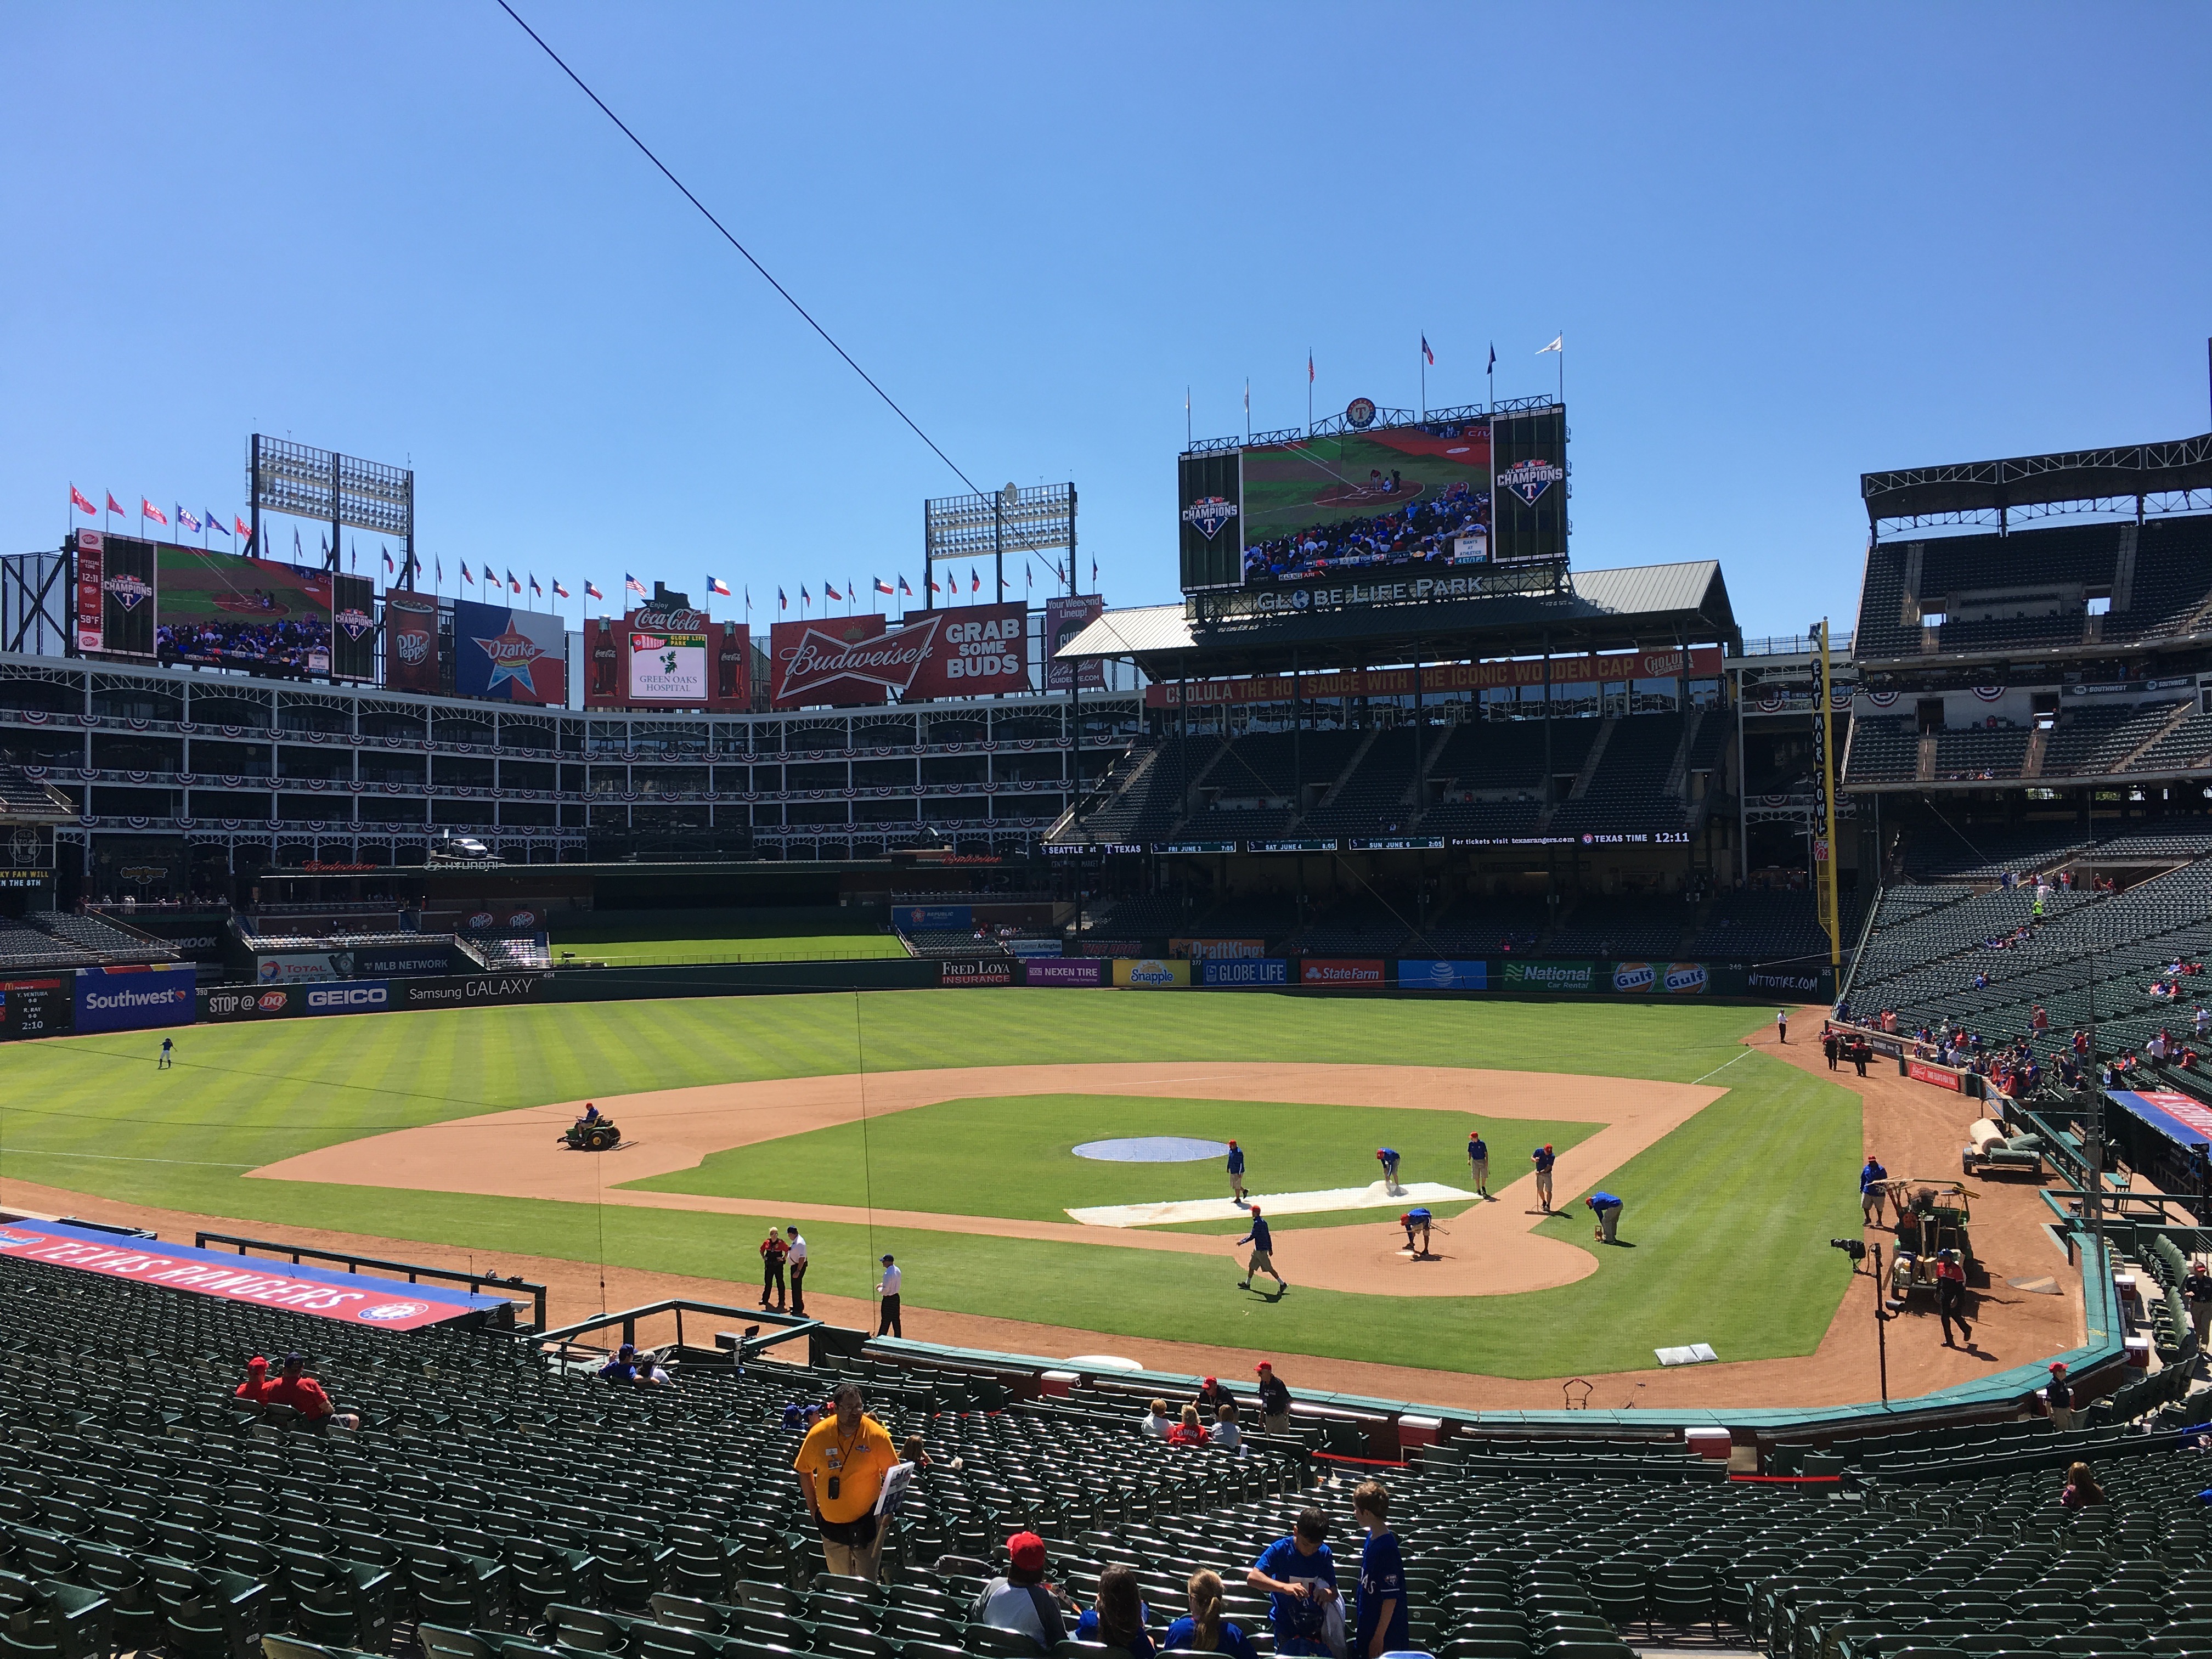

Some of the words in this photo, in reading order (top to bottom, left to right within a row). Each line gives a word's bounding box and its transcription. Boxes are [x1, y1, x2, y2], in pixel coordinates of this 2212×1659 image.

[1497, 468, 1563, 486] CHAMPIONS
[1182, 505, 1237, 521] CHAMPIONS
[82, 573, 98, 583] 12:11
[104, 580, 152, 596] CHAMPIONS
[1352, 583, 1406, 603] LIFE
[1416, 577, 1482, 597] PARK
[1048, 600, 1064, 610] Your
[1060, 607, 1087, 618] Lineup!
[335, 614, 373, 628] CHAMPIONS
[945, 618, 1020, 644] GRAB
[397, 635, 429, 662] Pepper
[407, 634, 422, 646] Dr
[641, 635, 665, 648] RANGERS
[958, 640, 1007, 657] SOME
[488, 640, 535, 659] Ozarka
[779, 644, 933, 676] Budweiser
[947, 654, 1019, 679] BUDS
[1238, 681, 1267, 698] THE
[1308, 674, 1359, 694] SAUCE
[1367, 671, 1408, 690] WITH
[1452, 666, 1508, 685] ICONIC
[1598, 658, 1634, 677] CAP
[1813, 662, 1821, 707] EAT
[2158, 679, 2188, 687] SOUTHWEST
[1815, 716, 1823, 761] MOR
[1816, 771, 1825, 833] FOWL
[1655, 832, 1690, 843] 12:11
[1048, 846, 1084, 854] SEATTLE
[1114, 845, 1141, 853] TEXAS
[445, 861, 498, 870] HYUNDAI
[1082, 943, 1107, 955] TIRE
[1108, 943, 1143, 955] PROS
[285, 964, 327, 973] TOTAL
[374, 961, 396, 971] MLB
[399, 959, 448, 970] NETWORK
[941, 961, 975, 975] FRED
[978, 959, 1011, 974] LOYA
[1076, 968, 1098, 977] TIRE
[1220, 965, 1255, 981] GLOBE
[1260, 964, 1284, 981] LIFE
[1523, 966, 1591, 981] National
[943, 974, 1011, 984] INSURANCE
[1131, 969, 1173, 986] Snapple
[1617, 970, 1655, 987] Gulf
[1666, 969, 1706, 988] Gulf
[1748, 972, 1818, 991] NITTOTIRE.COM
[308, 988, 387, 1006] GEICO
[409, 987, 461, 1000] Samsung
[466, 978, 533, 997] GALAXY
[86, 989, 174, 1009] Southwest
[210, 996, 239, 1013] STOP
[241, 995, 255, 1011] @
[263, 995, 283, 1008] DQ
[22, 1020, 43, 1030] 2:10
[26, 1243, 172, 1273] TEXAS
[146, 1265, 365, 1308] RANGERS
